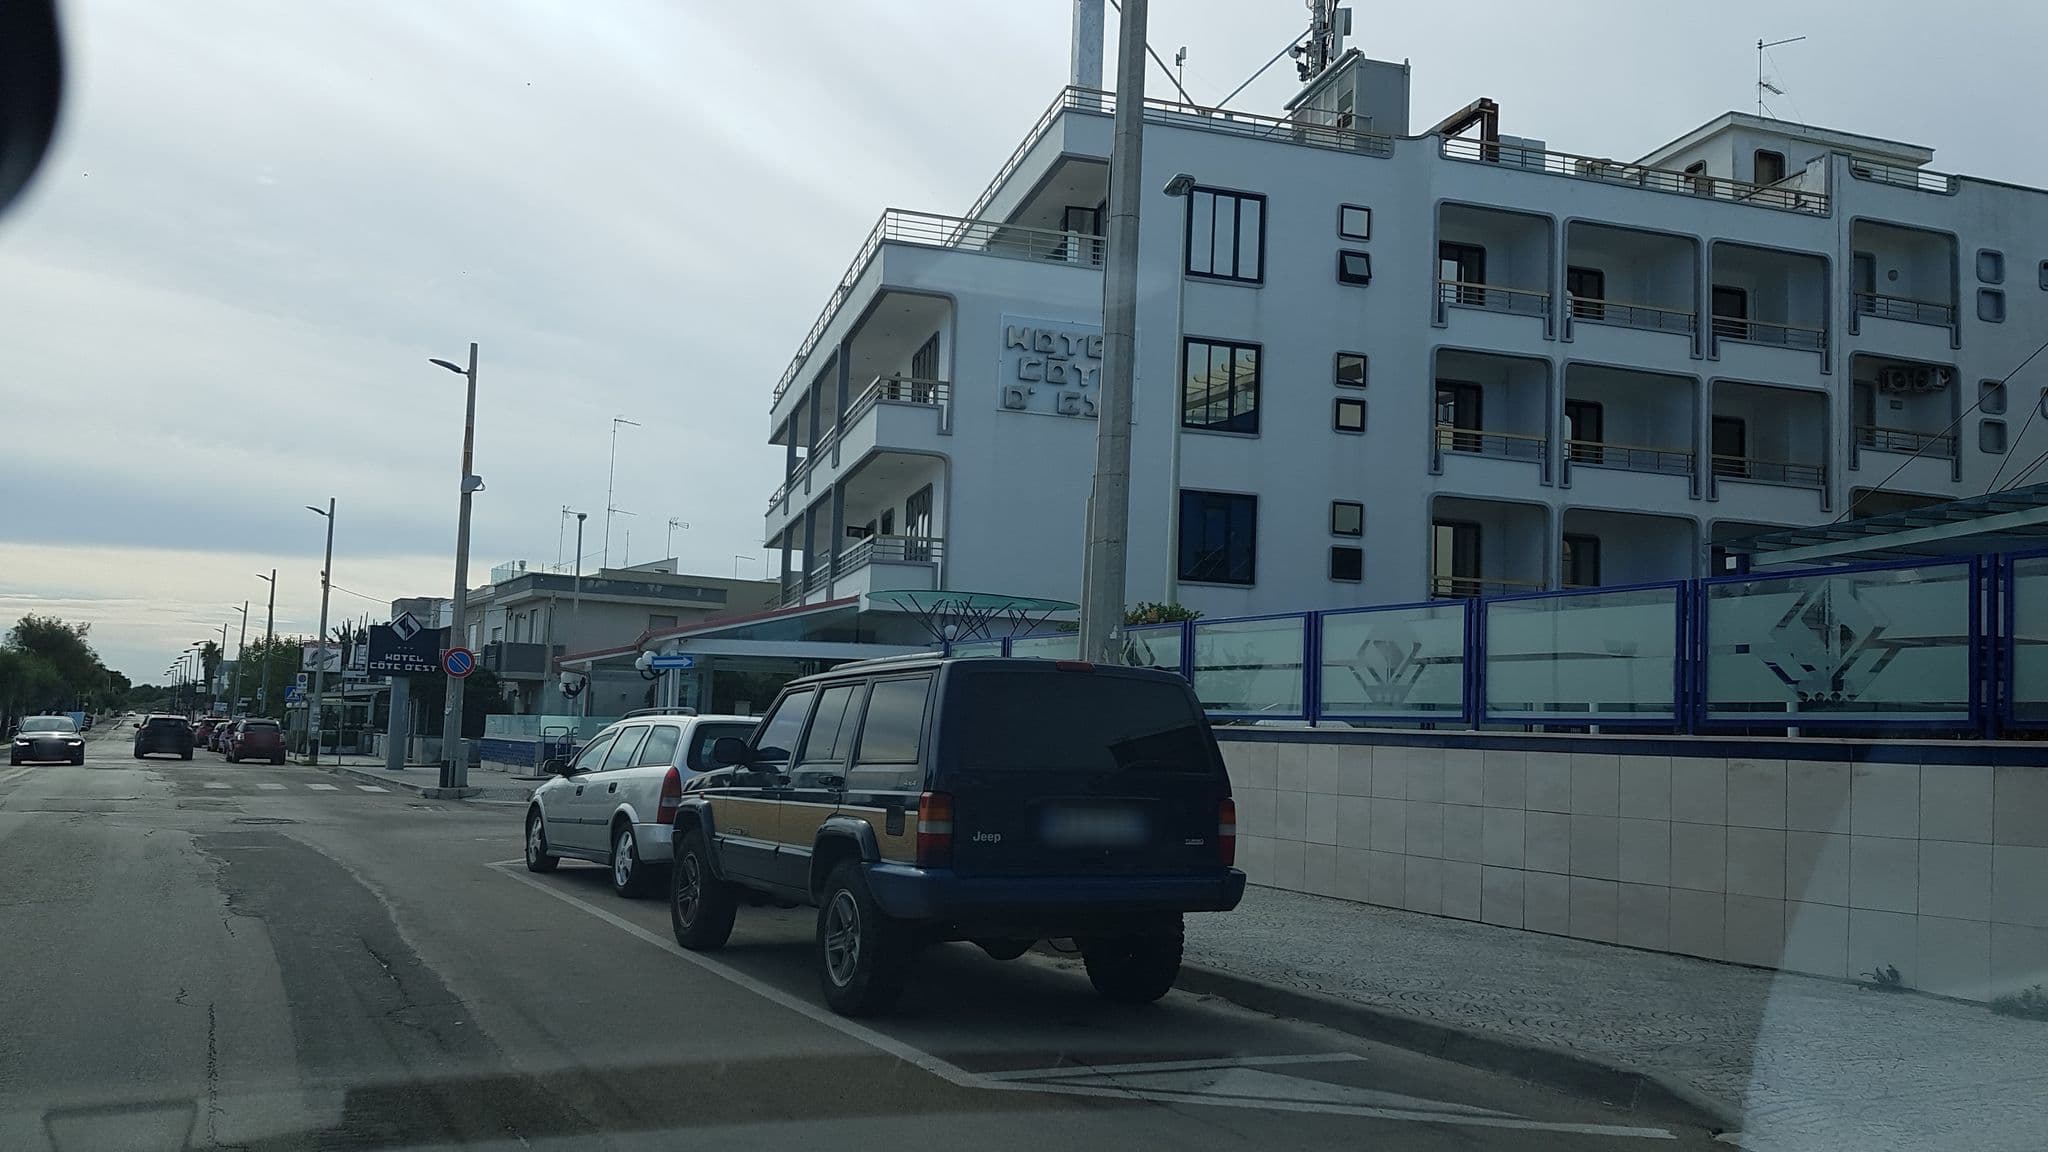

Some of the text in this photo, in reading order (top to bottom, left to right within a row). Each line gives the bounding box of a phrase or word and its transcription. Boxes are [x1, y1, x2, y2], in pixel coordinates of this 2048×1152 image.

[1007, 325, 1104, 358] HOTE
[1057, 391, 1100, 417] ES
[385, 653, 424, 662] HOTEL
[973, 831, 1001, 843] Jeep
